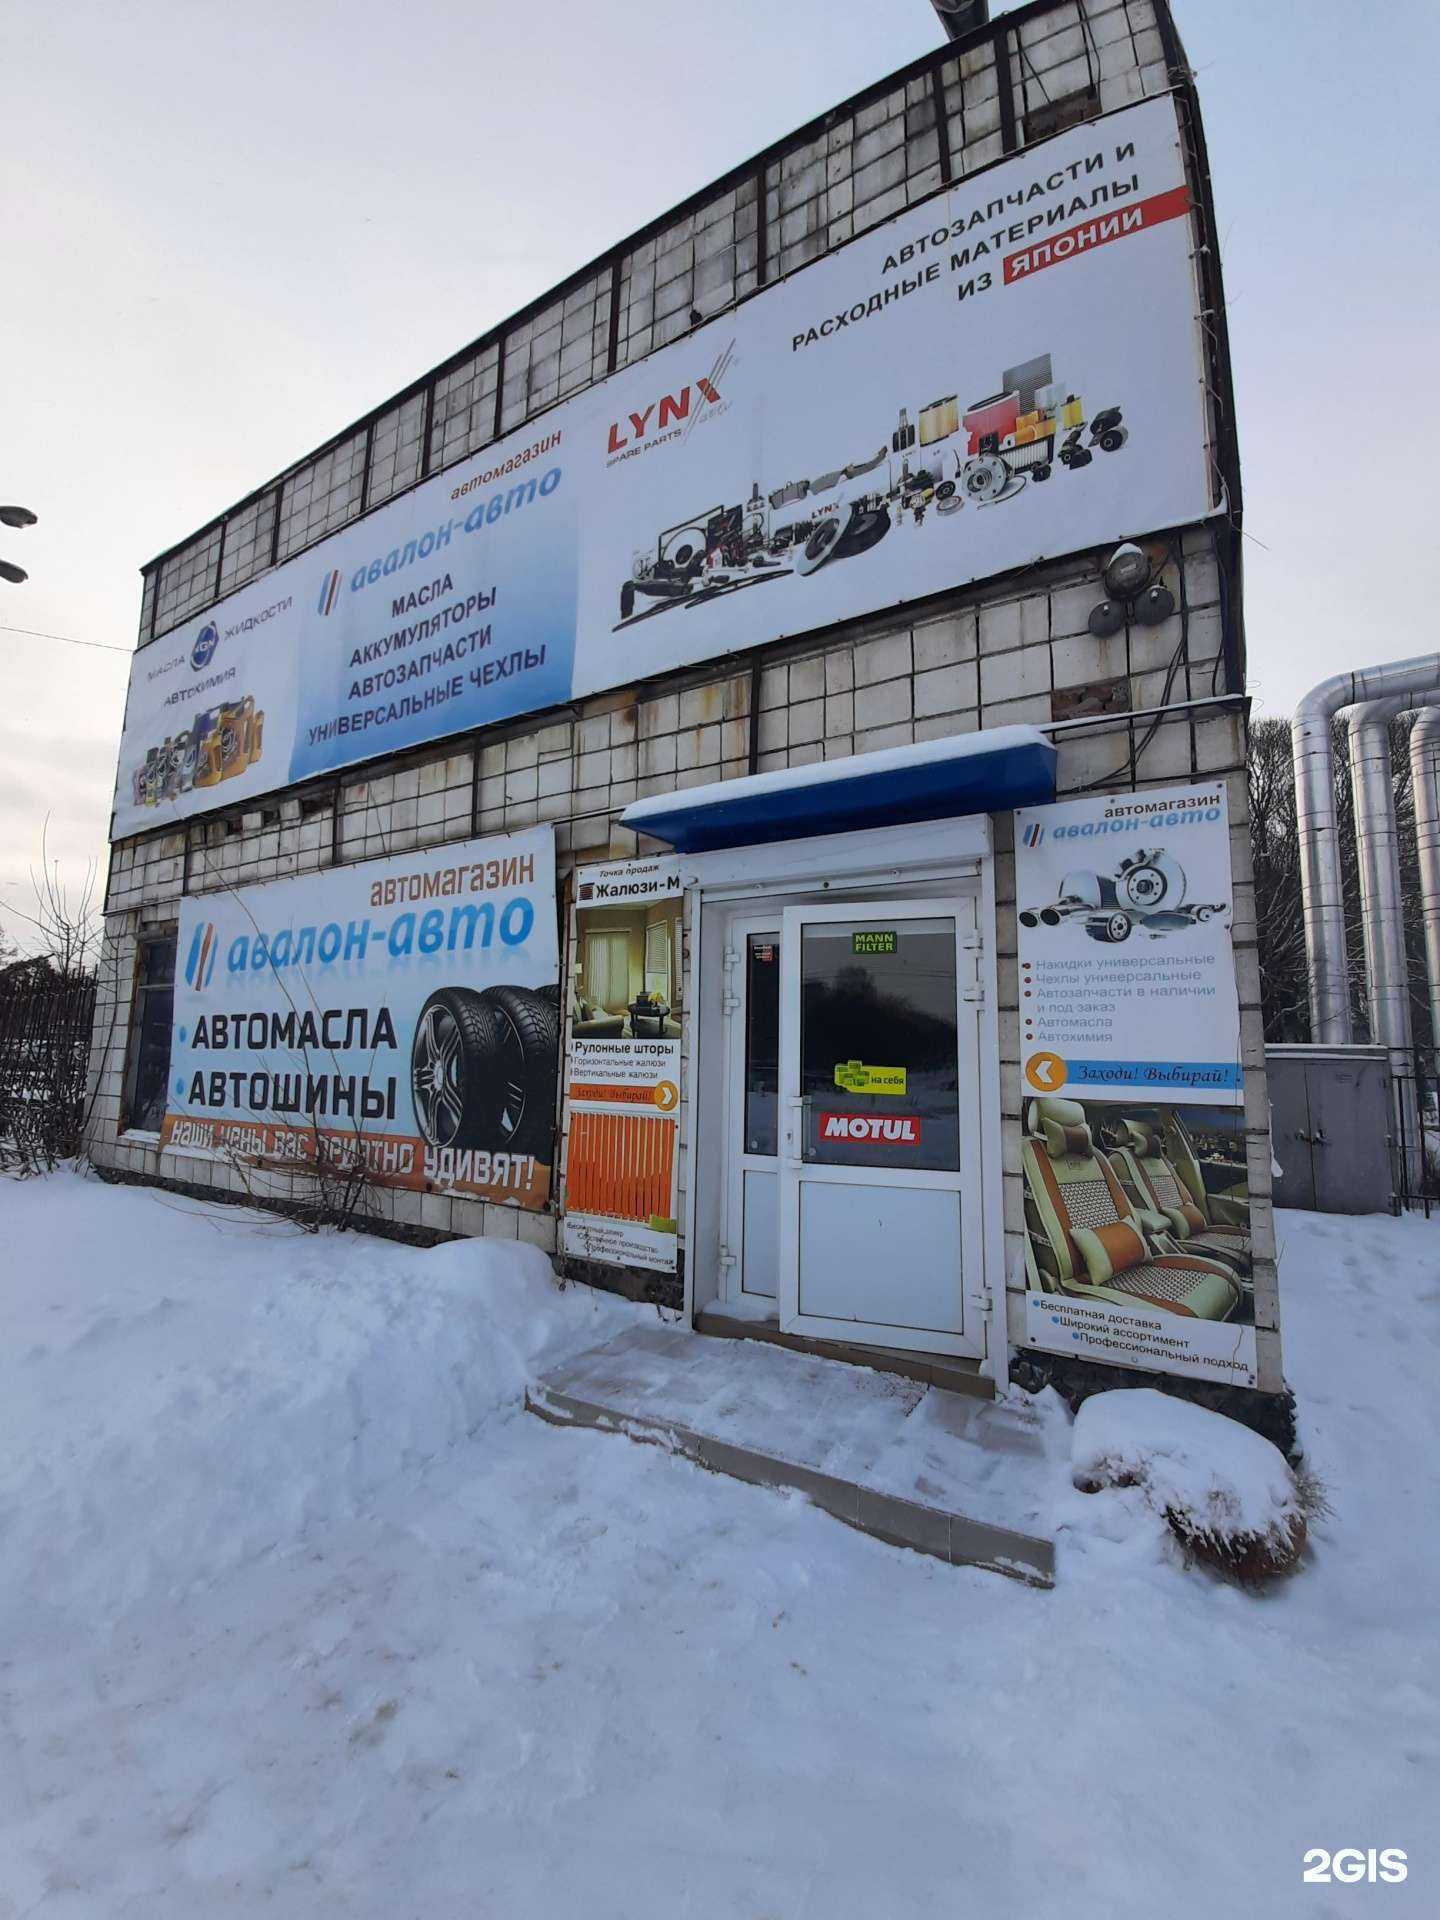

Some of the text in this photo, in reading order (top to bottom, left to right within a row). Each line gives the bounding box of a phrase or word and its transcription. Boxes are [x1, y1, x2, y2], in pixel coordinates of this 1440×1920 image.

[882, 142, 1135, 274] АВТОЗАПЧАСТИ И
[792, 174, 1139, 351] РАСХОДНЫЕ МАТЕРИАЛЫ
[957, 207, 1143, 301] ИЗ ЯПОНИИ
[608, 360, 731, 454] LYNX
[450, 429, 561, 501] автомагазин
[606, 429, 682, 468] SPARE PARTS
[350, 466, 562, 593] авалон-авто
[391, 573, 453, 617] МАСЛА
[224, 596, 293, 641] ЖИДКОСТИ
[349, 586, 497, 668] АККУМУЛЯТОРЫ
[147, 654, 185, 682] МАСЛА
[347, 624, 492, 700] АВТОЗАПЧАСТИ
[163, 667, 236, 708] АВТОХИМИЯ
[308, 645, 547, 746] УНИВЕРСАЛЬНЫЕ ЧЕХЛЫ
[1052, 807, 1221, 840] авалон-авто
[1103, 795, 1221, 818] автомагазин
[370, 853, 535, 907] автомагазин
[600, 864, 660, 878] Точка продаж
[227, 897, 535, 974] авалон-авто
[855, 932, 893, 943] MANN
[855, 942, 893, 952] FILTER
[1036, 955, 1215, 970] Накидки универсальные
[1036, 971, 1202, 985] Чехлы универсальные
[1036, 986, 1216, 998] Автозапчасти в наличии
[1049, 1003, 1073, 1014] под
[1077, 1003, 1115, 1012] заказ
[191, 1007, 398, 1049] АВТОМАСЛА
[1037, 1017, 1113, 1027] Автомасла
[1037, 1032, 1113, 1042] Автохимия
[575, 1041, 674, 1056] Рулонные шторы
[189, 1070, 398, 1120] АВТОШИНЫ
[824, 1117, 916, 1140] MOTUL
[1040, 1299, 1162, 1331] Бесплатная доставка
[1059, 1315, 1190, 1349] Широкий ассортимент
[1080, 1332, 1248, 1372] Профессиональный подход
